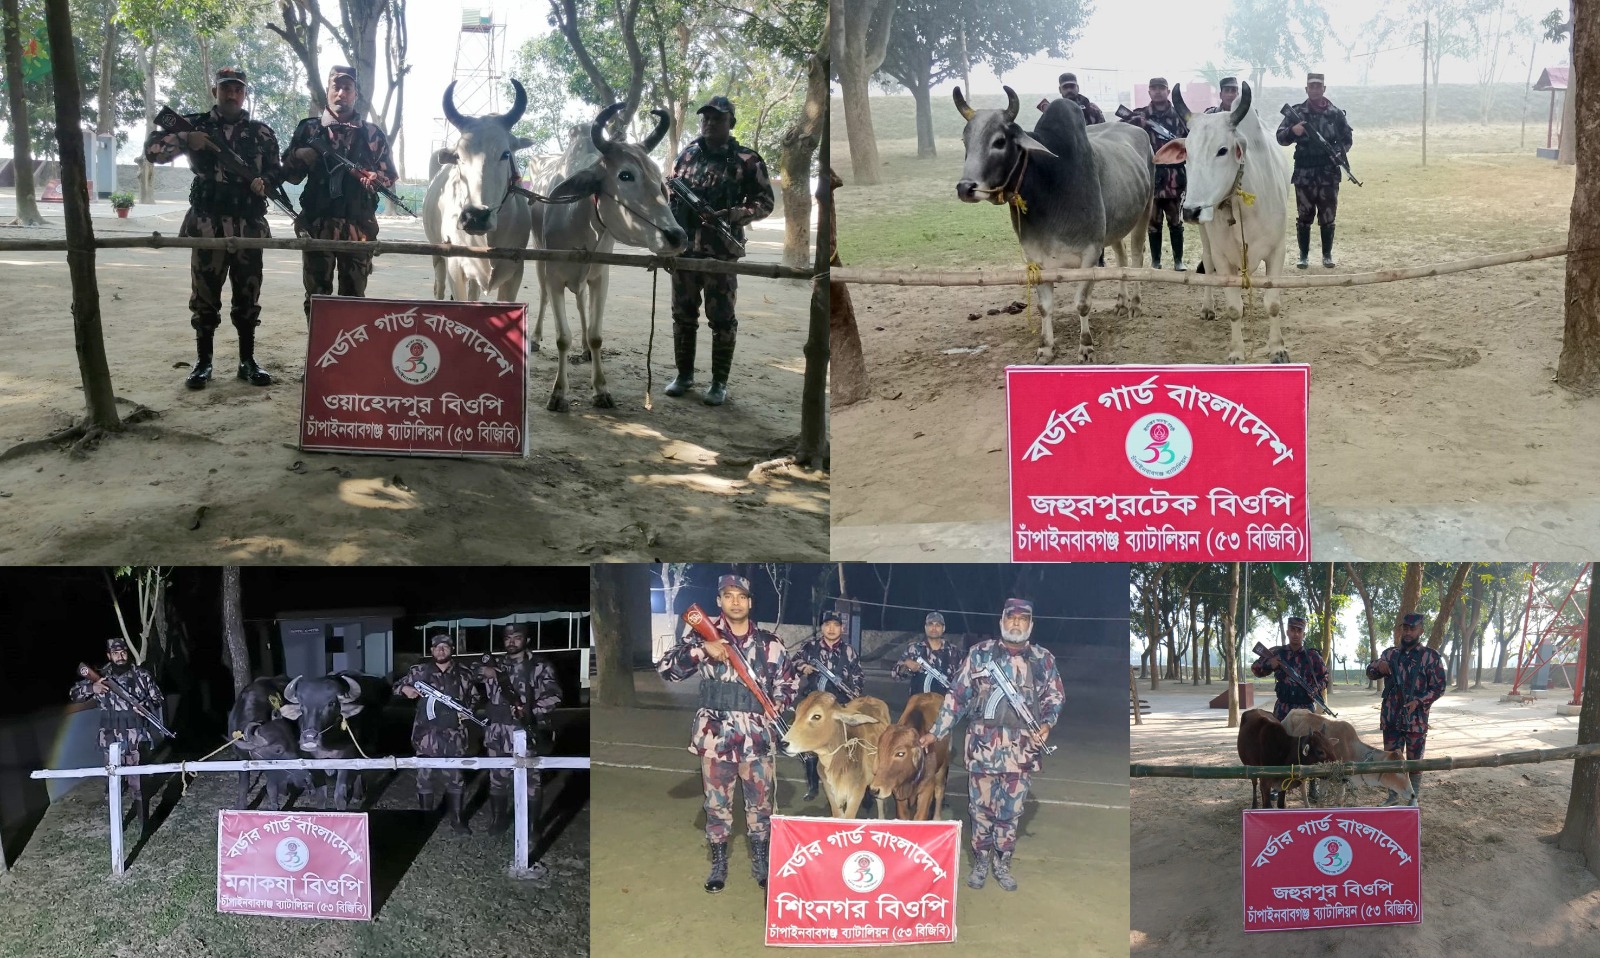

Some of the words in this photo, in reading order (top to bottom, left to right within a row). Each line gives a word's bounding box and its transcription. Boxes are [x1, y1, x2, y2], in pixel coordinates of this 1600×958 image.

[315, 324, 369, 368] বর্ডার
[374, 307, 420, 332] গার্ড
[423, 313, 513, 377] বাংলাদেশ
[322, 393, 434, 418] ওয়াহেদপুর
[440, 392, 504, 415] বিওপি
[1021, 402, 1092, 462] বর্ডার
[1098, 375, 1160, 411] গার্ড
[1164, 384, 1293, 466] বাংলাদেশ
[307, 415, 383, 439] চাঁপাইনবাবগঞ্জ
[387, 419, 444, 442] ব্যাটালিয়ন
[447, 423, 473, 447] (৫৩
[477, 421, 521, 448] বিজিবি)
[1027, 488, 1199, 523] জহুরপুরটেক
[1206, 487, 1295, 516] বিওপি
[1016, 523, 1119, 552] চাঁপাইনবাবগঞ্জ
[1124, 524, 1201, 552] ব্যাটালিয়ন
[1206, 527, 1240, 556] (৫৩
[1246, 523, 1304, 555] বিজিবি)
[227, 828, 261, 858] বর্ডার
[264, 816, 293, 834] গার্ড
[295, 818, 361, 865] বাংলাদেশ
[776, 840, 823, 878] বর্ডার
[827, 825, 867, 848] গার্ড
[870, 830, 946, 883] বাংলাদেশ
[1251, 830, 1293, 867] বর্ডার
[1297, 814, 1333, 835] গার্ড
[1336, 818, 1411, 866] বাংলাদেশ
[223, 874, 296, 896] মনাকষা
[301, 872, 364, 897] বিওপি
[1272, 883, 1338, 902] জহুরপুর
[1343, 879, 1394, 897] বিওপি
[317, 900, 333, 913] (৫৩
[336, 900, 367, 915] বিজিবি)
[775, 892, 869, 921] শিংনগর
[875, 893, 949, 920] বিওপি
[1247, 906, 1310, 923] চাঁপাইনবাবগঞ্জ
[1313, 902, 1357, 920] ব্যাটালিয়ন
[1361, 903, 1381, 920] (৫৩
[1384, 900, 1418, 918] বিজিবি)
[769, 924, 838, 939] চাঁপাইনবাবগঞ্জ
[841, 925, 889, 939] ব্যাটালিয়ন
[892, 926, 912, 942] (৫৩
[915, 924, 950, 942] বিজিবি)
